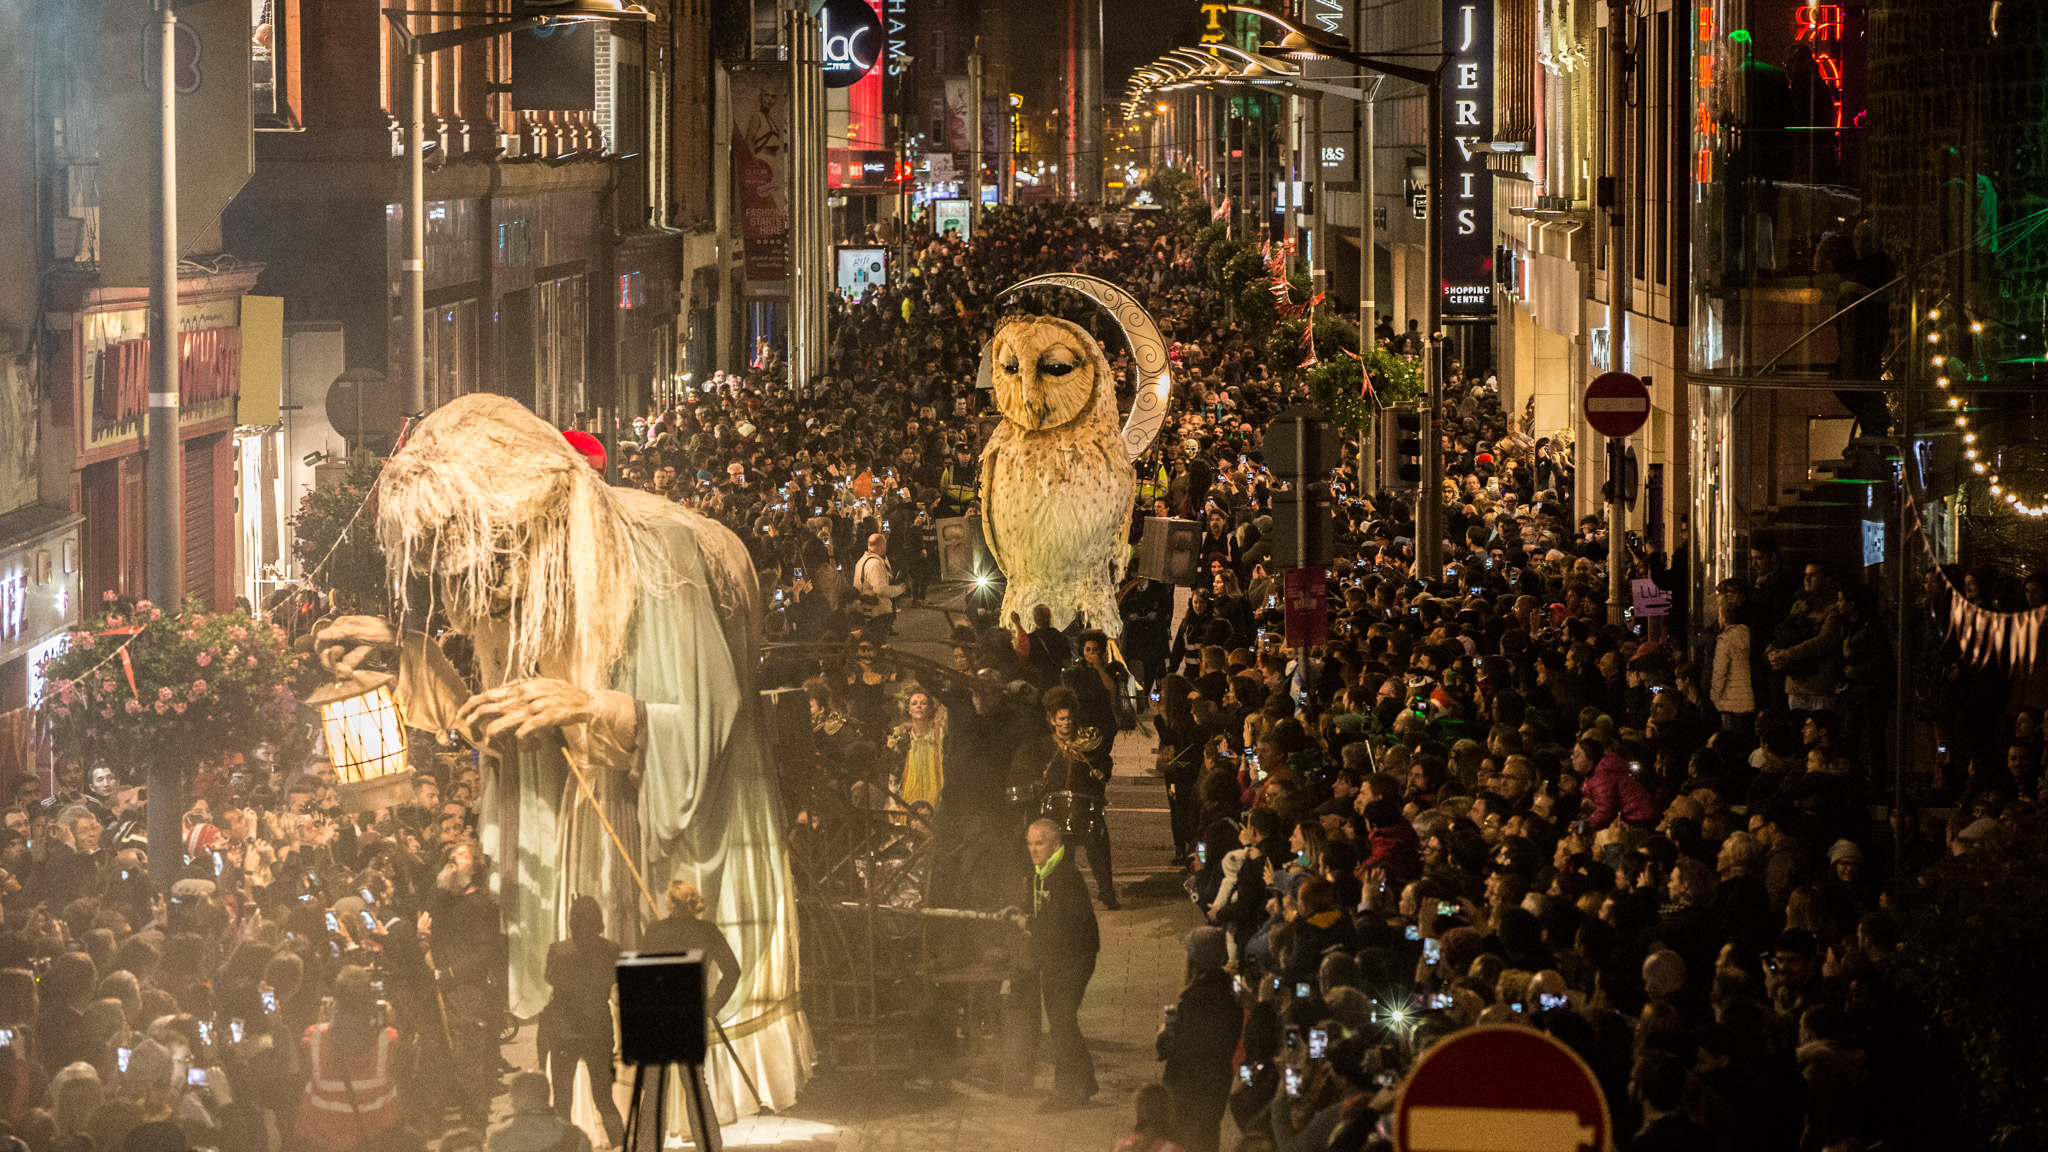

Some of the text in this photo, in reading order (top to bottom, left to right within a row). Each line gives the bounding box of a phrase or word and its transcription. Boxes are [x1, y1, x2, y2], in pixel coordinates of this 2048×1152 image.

[819, 8, 870, 69] lac
[1455, 5, 1481, 236] JERVIS
[750, 216, 782, 226] STARTS
[760, 225, 782, 235] HERE
[1444, 286, 1490, 294] SHOPPING
[1450, 295, 1484, 303] CENTRE
